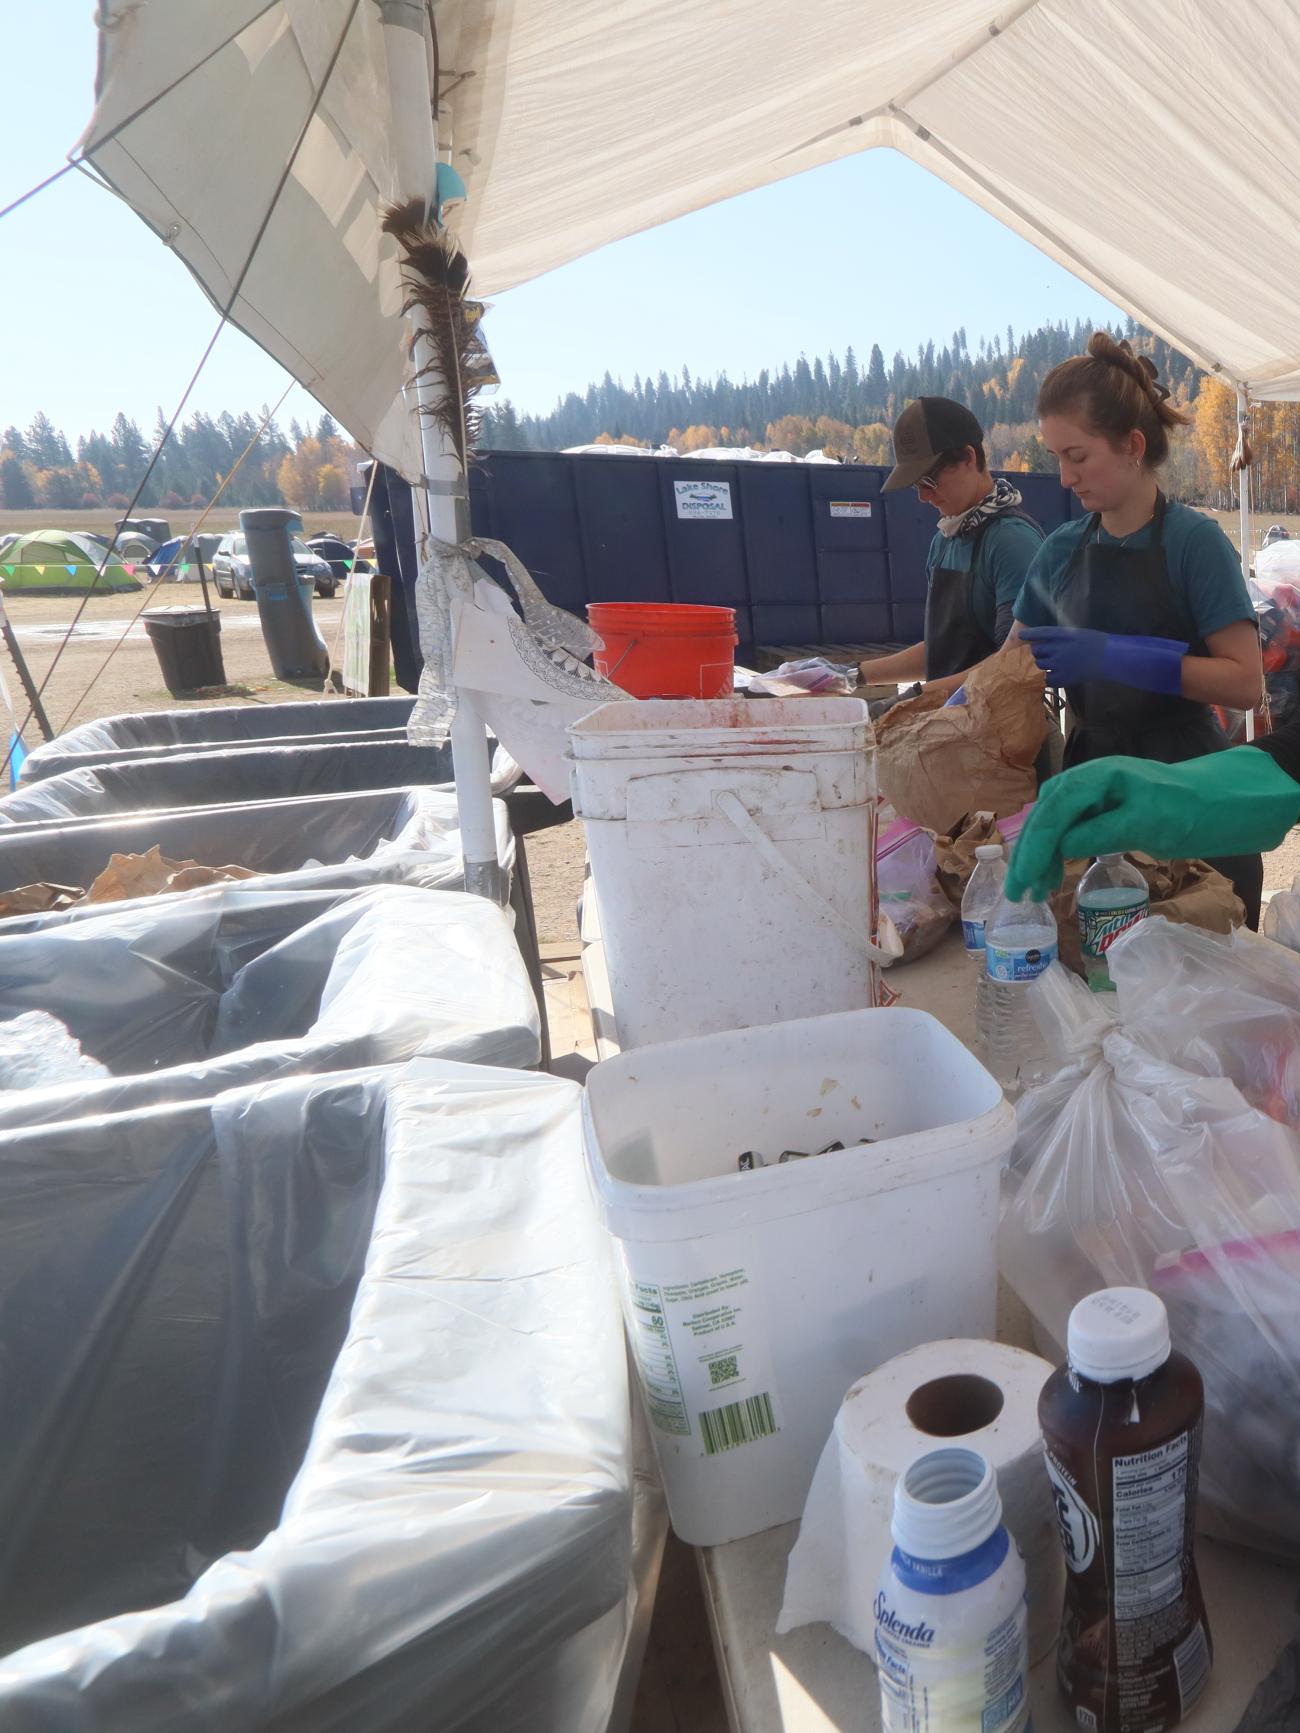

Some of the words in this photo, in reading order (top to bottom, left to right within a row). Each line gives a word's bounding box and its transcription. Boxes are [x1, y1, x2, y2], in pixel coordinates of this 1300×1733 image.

[676, 483, 698, 495] Lake
[701, 482, 728, 496] Shore
[682, 502, 727, 511] DISPOSAL
[1115, 1450, 1164, 1468] Nutrition
[1165, 1435, 1187, 1454] Facts
[1116, 1486, 1153, 1498] Calories
[912, 1562, 943, 1577] VANILLA
[873, 1591, 936, 1643] Splenda
